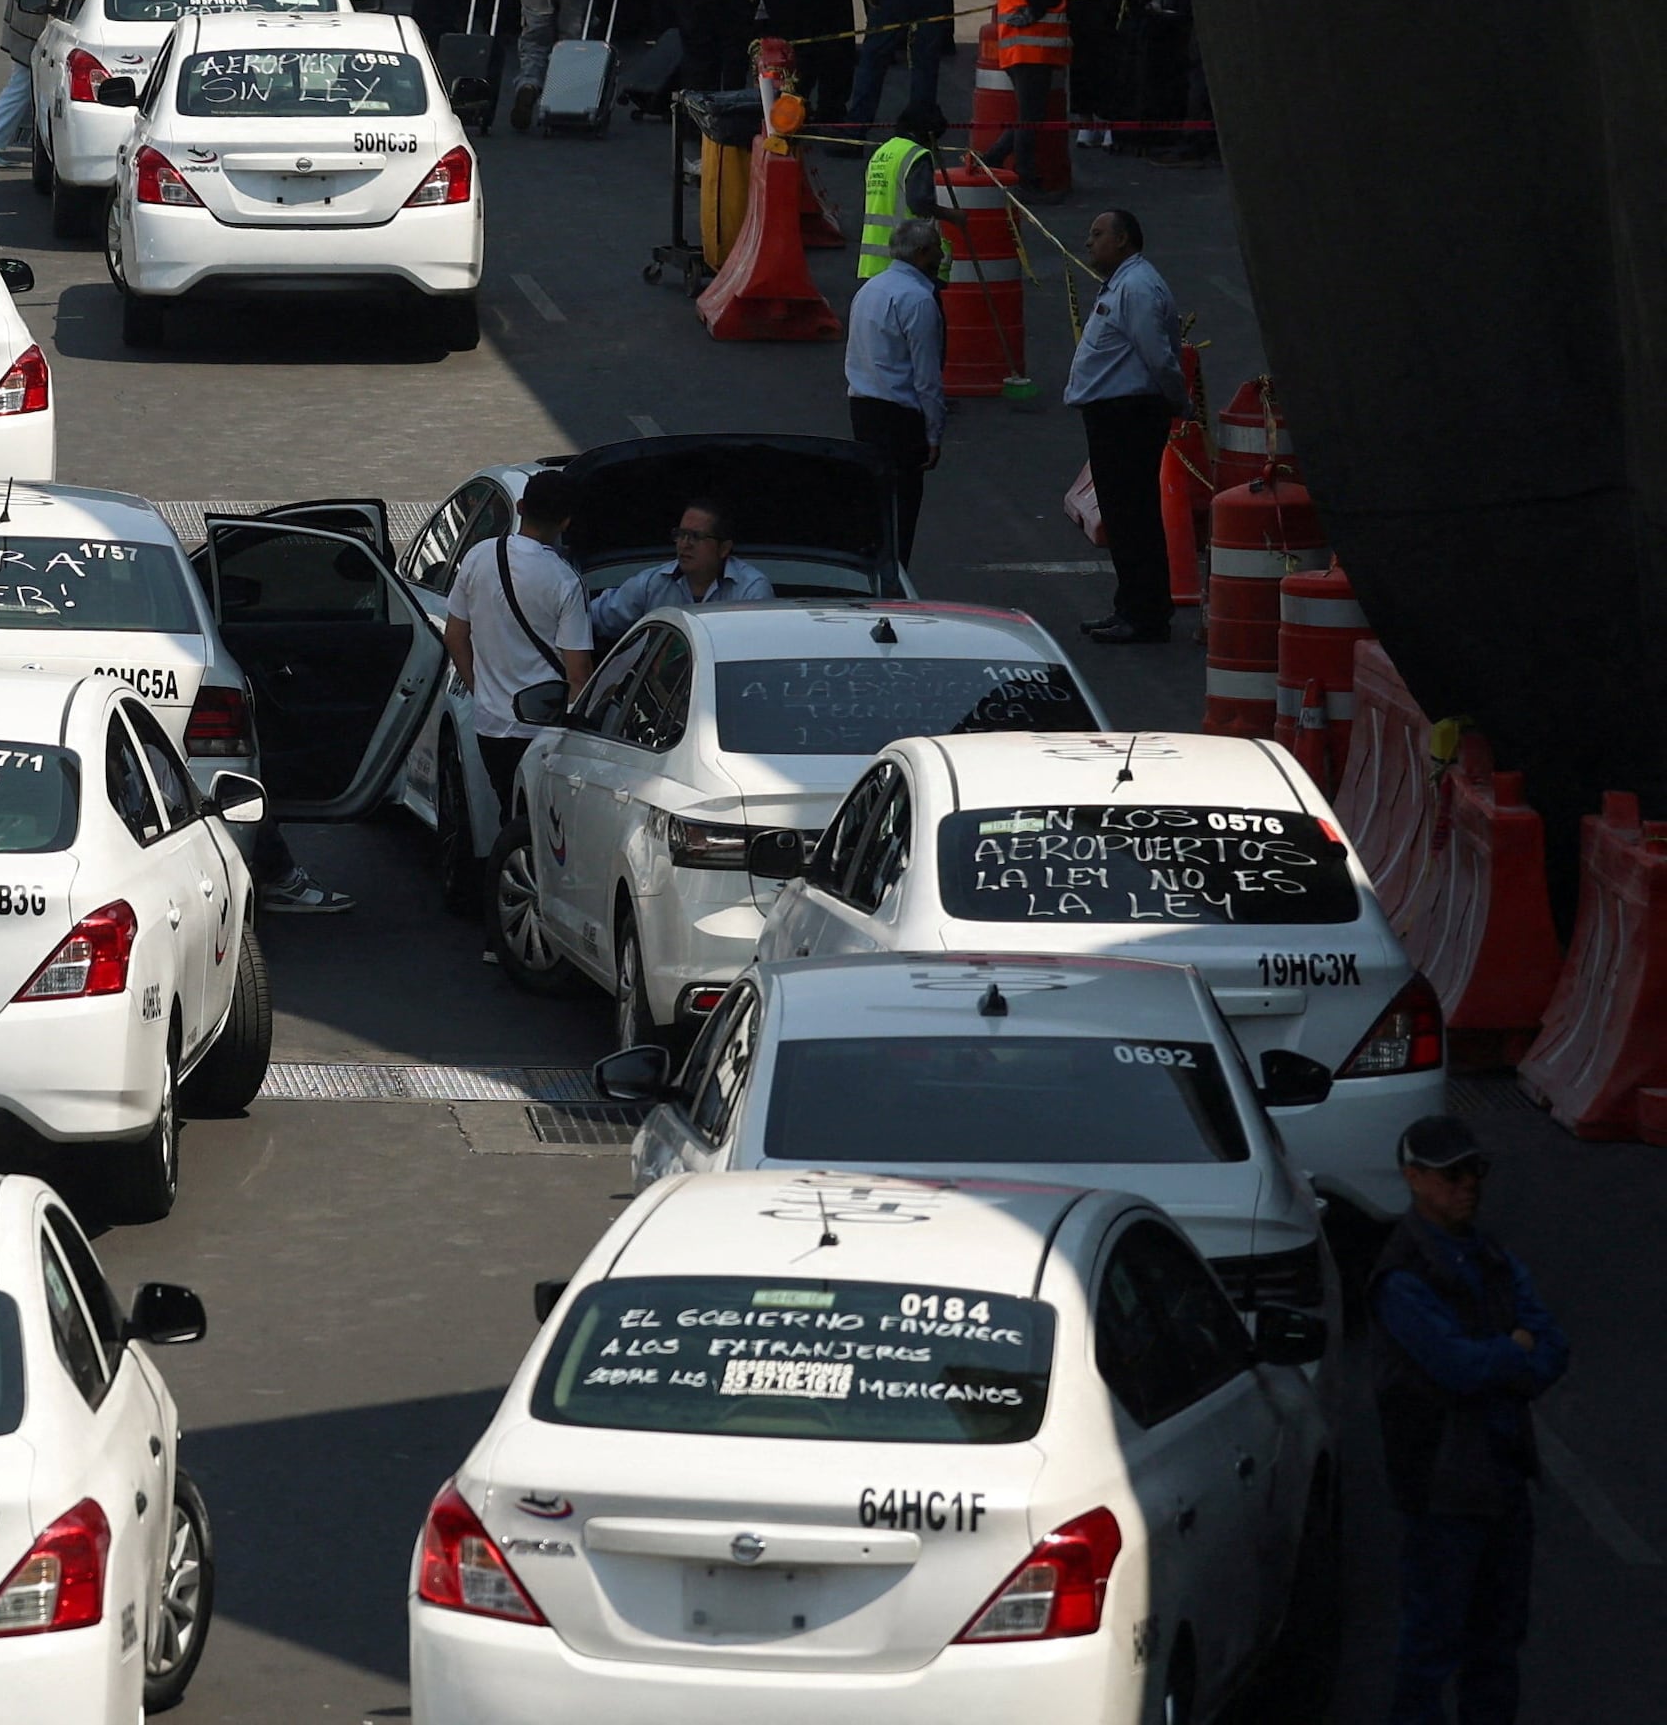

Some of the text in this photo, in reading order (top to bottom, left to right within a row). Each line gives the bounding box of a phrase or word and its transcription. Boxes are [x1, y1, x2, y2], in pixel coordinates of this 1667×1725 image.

[354, 53, 401, 68] 1585
[200, 76, 382, 115] SIN LEY
[78, 542, 139, 563] 1757
[983, 665, 1051, 684] 1100
[1009, 807, 1201, 834] EN LOS
[1207, 812, 1287, 836] 0576
[974, 834, 1320, 866] AEROPUERTOS
[975, 866, 1309, 896] LA LEY NO ES
[1026, 891, 1236, 922] LA LEY
[1257, 953, 1362, 988] 19HC3K
[1113, 1042, 1198, 1069] 0692
[619, 1308, 663, 1330] EL
[677, 1308, 865, 1333] GOBIERNO
[899, 1292, 991, 1324] 0184
[600, 1337, 933, 1364] A LOS EXTRANJEROS
[724, 1358, 855, 1378] RESERVACIONES
[857, 1377, 1024, 1407] MEXICANOS
[858, 1487, 986, 1534] 64HC1F
